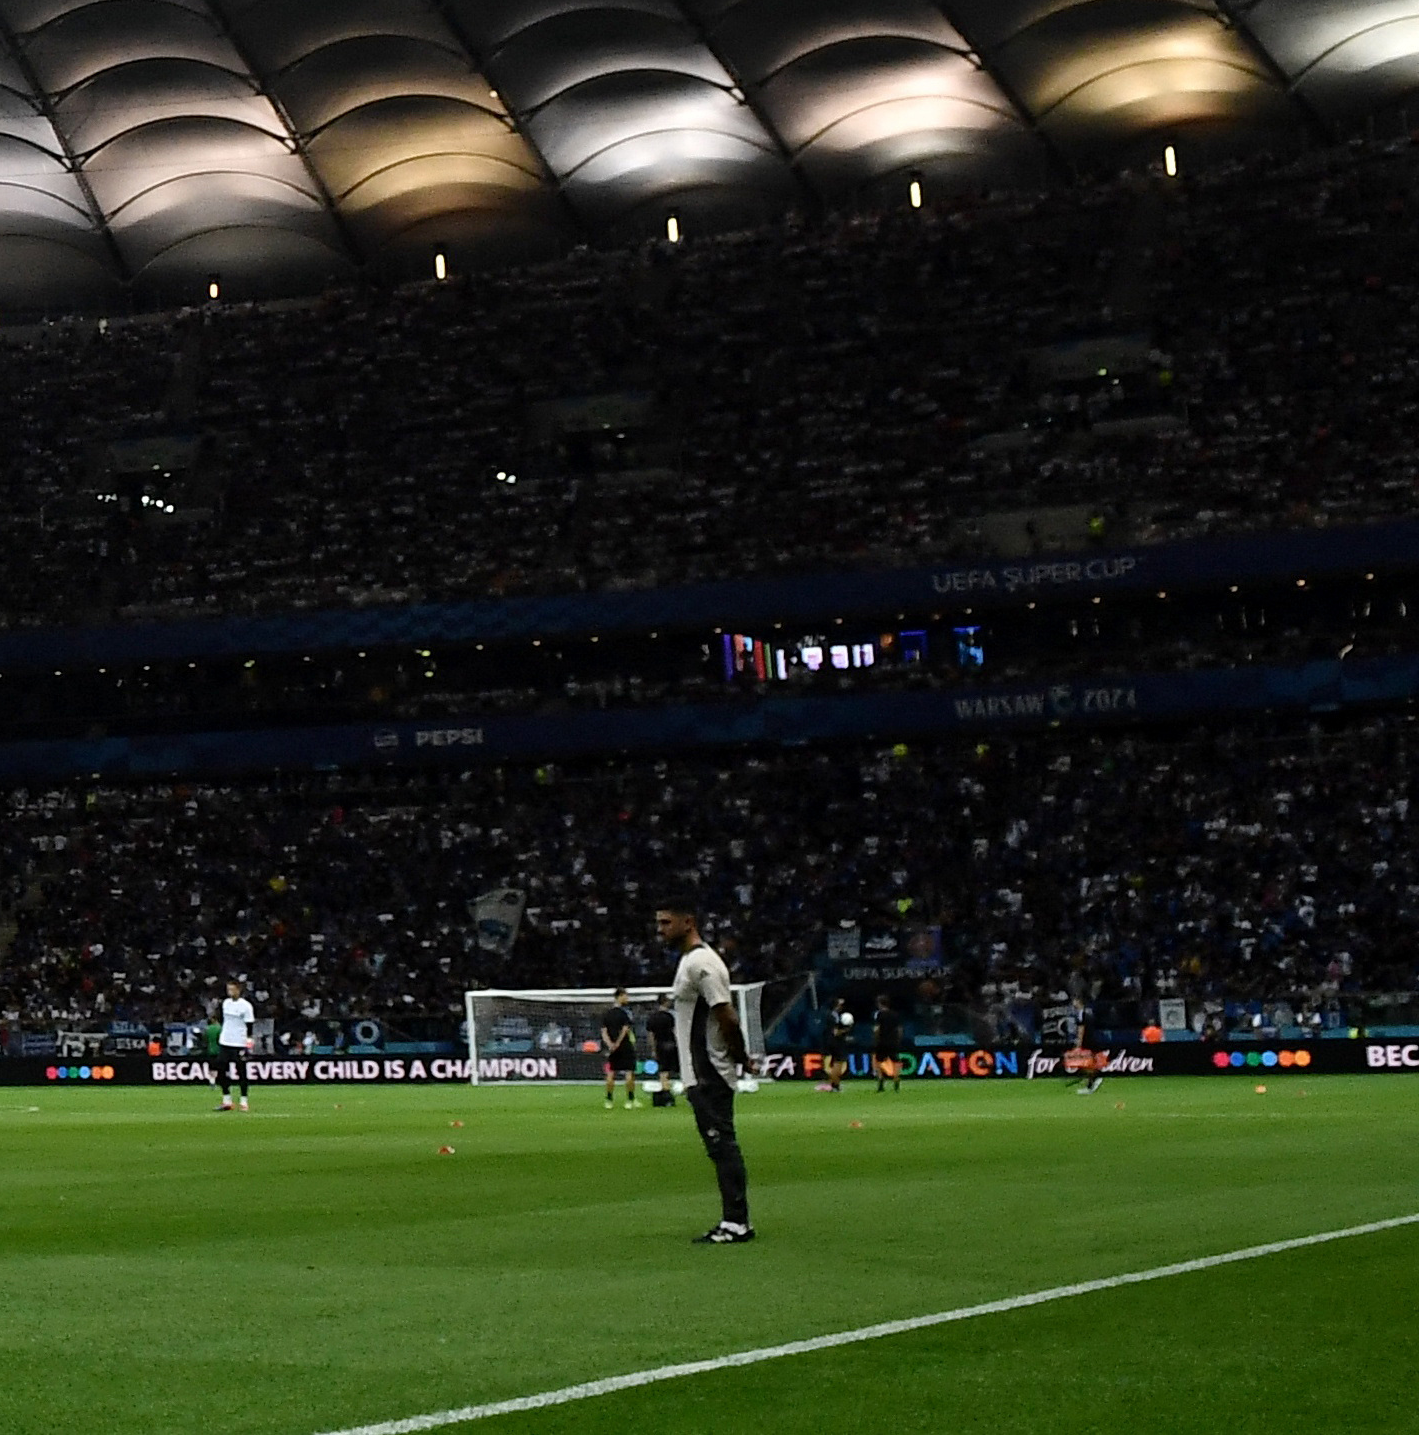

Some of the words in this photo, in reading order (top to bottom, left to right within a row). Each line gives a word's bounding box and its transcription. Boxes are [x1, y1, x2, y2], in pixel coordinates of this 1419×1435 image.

[932, 570, 997, 594] UEFA
[1003, 565, 1083, 587] SUPER
[1086, 557, 1136, 579] CUP
[954, 694, 1044, 719] WARSAW
[1083, 688, 1137, 710] 2024
[415, 728, 484, 747] PEPSI
[152, 1062, 240, 1080] BECAE
[245, 1061, 309, 1080] EVERY
[313, 1060, 380, 1079] CHILD
[383, 1060, 406, 1079] IS
[408, 1060, 428, 1079] A
[429, 1058, 558, 1079] CHAMPION
[1026, 1048, 1061, 1080] for
[1365, 1044, 1419, 1068] BEC
